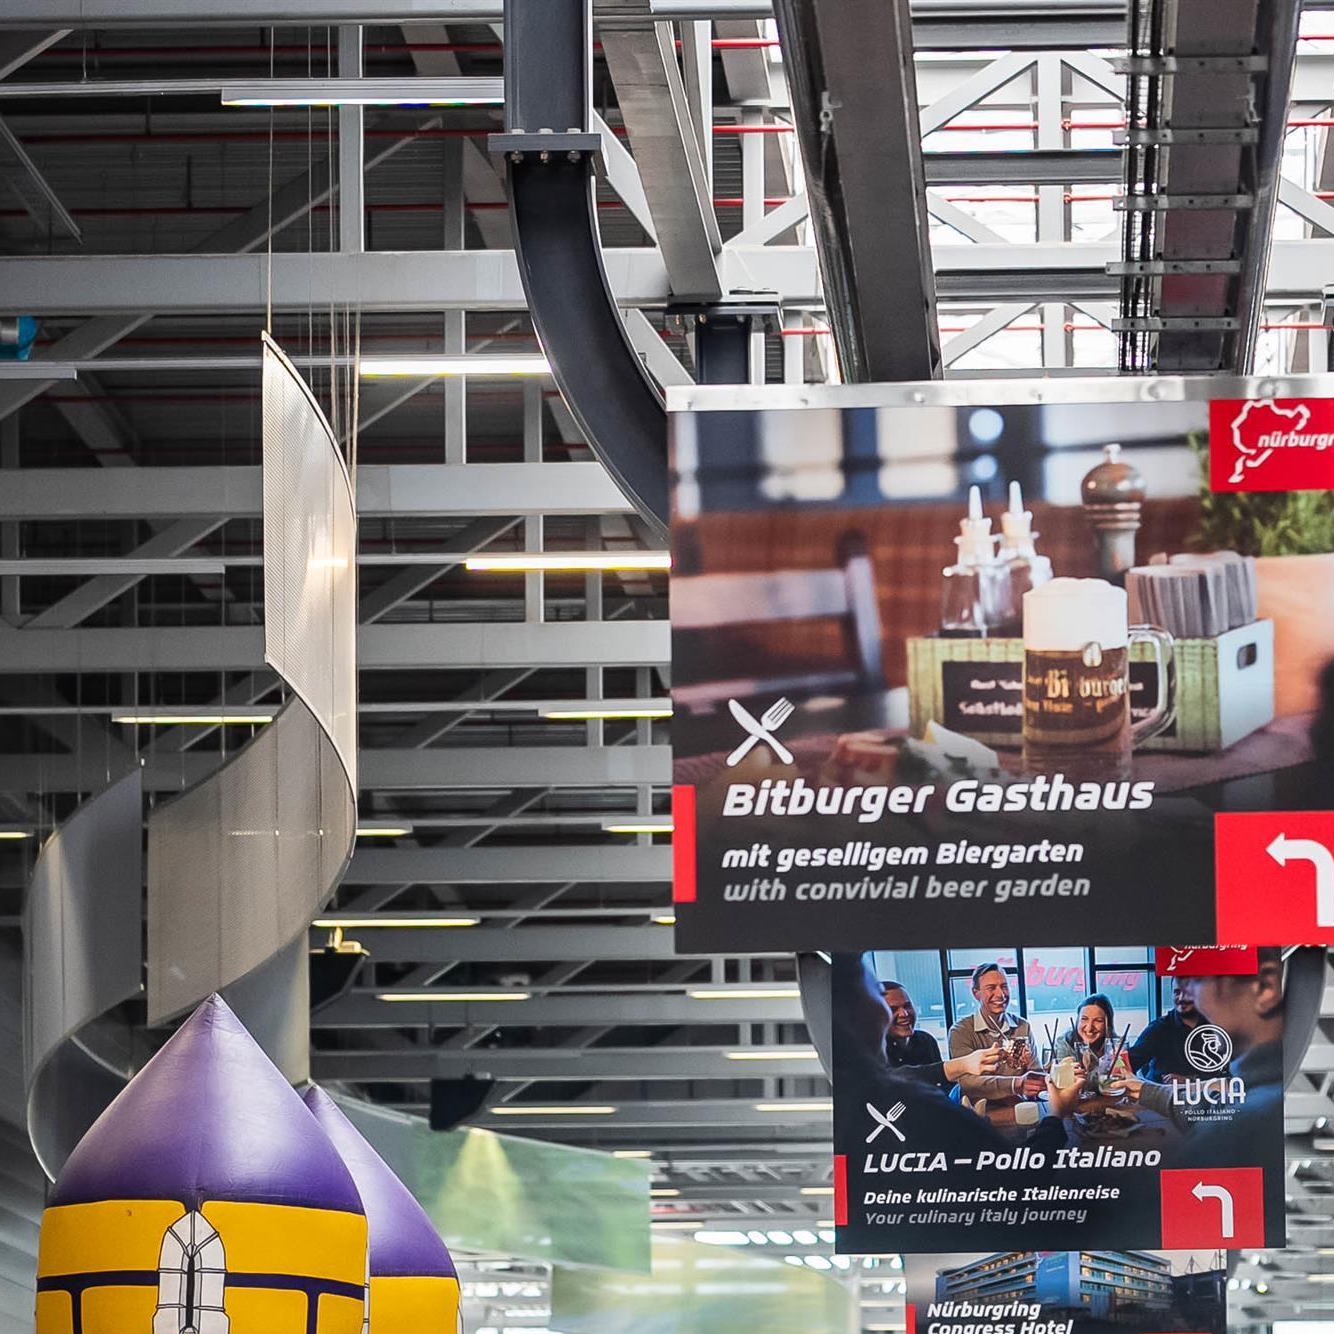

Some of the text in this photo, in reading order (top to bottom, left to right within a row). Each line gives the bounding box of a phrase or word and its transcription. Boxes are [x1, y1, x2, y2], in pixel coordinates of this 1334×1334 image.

[722, 775, 1154, 823] Bitburger Gasthaus
[722, 839, 1083, 873] mit geselligem Biergarten
[723, 874, 1091, 902] with convivial beer garden
[1172, 1077, 1246, 1105] LUCIA
[863, 1153, 948, 1173] LUCIA
[976, 1149, 1046, 1171] Pollo
[1053, 1147, 1161, 1169] Italiano
[864, 1186, 1120, 1205] Deine kulinarische Italienreise
[864, 1208, 1087, 1226] Your culinary italy journey
[927, 1301, 1041, 1321] Nürburgring
